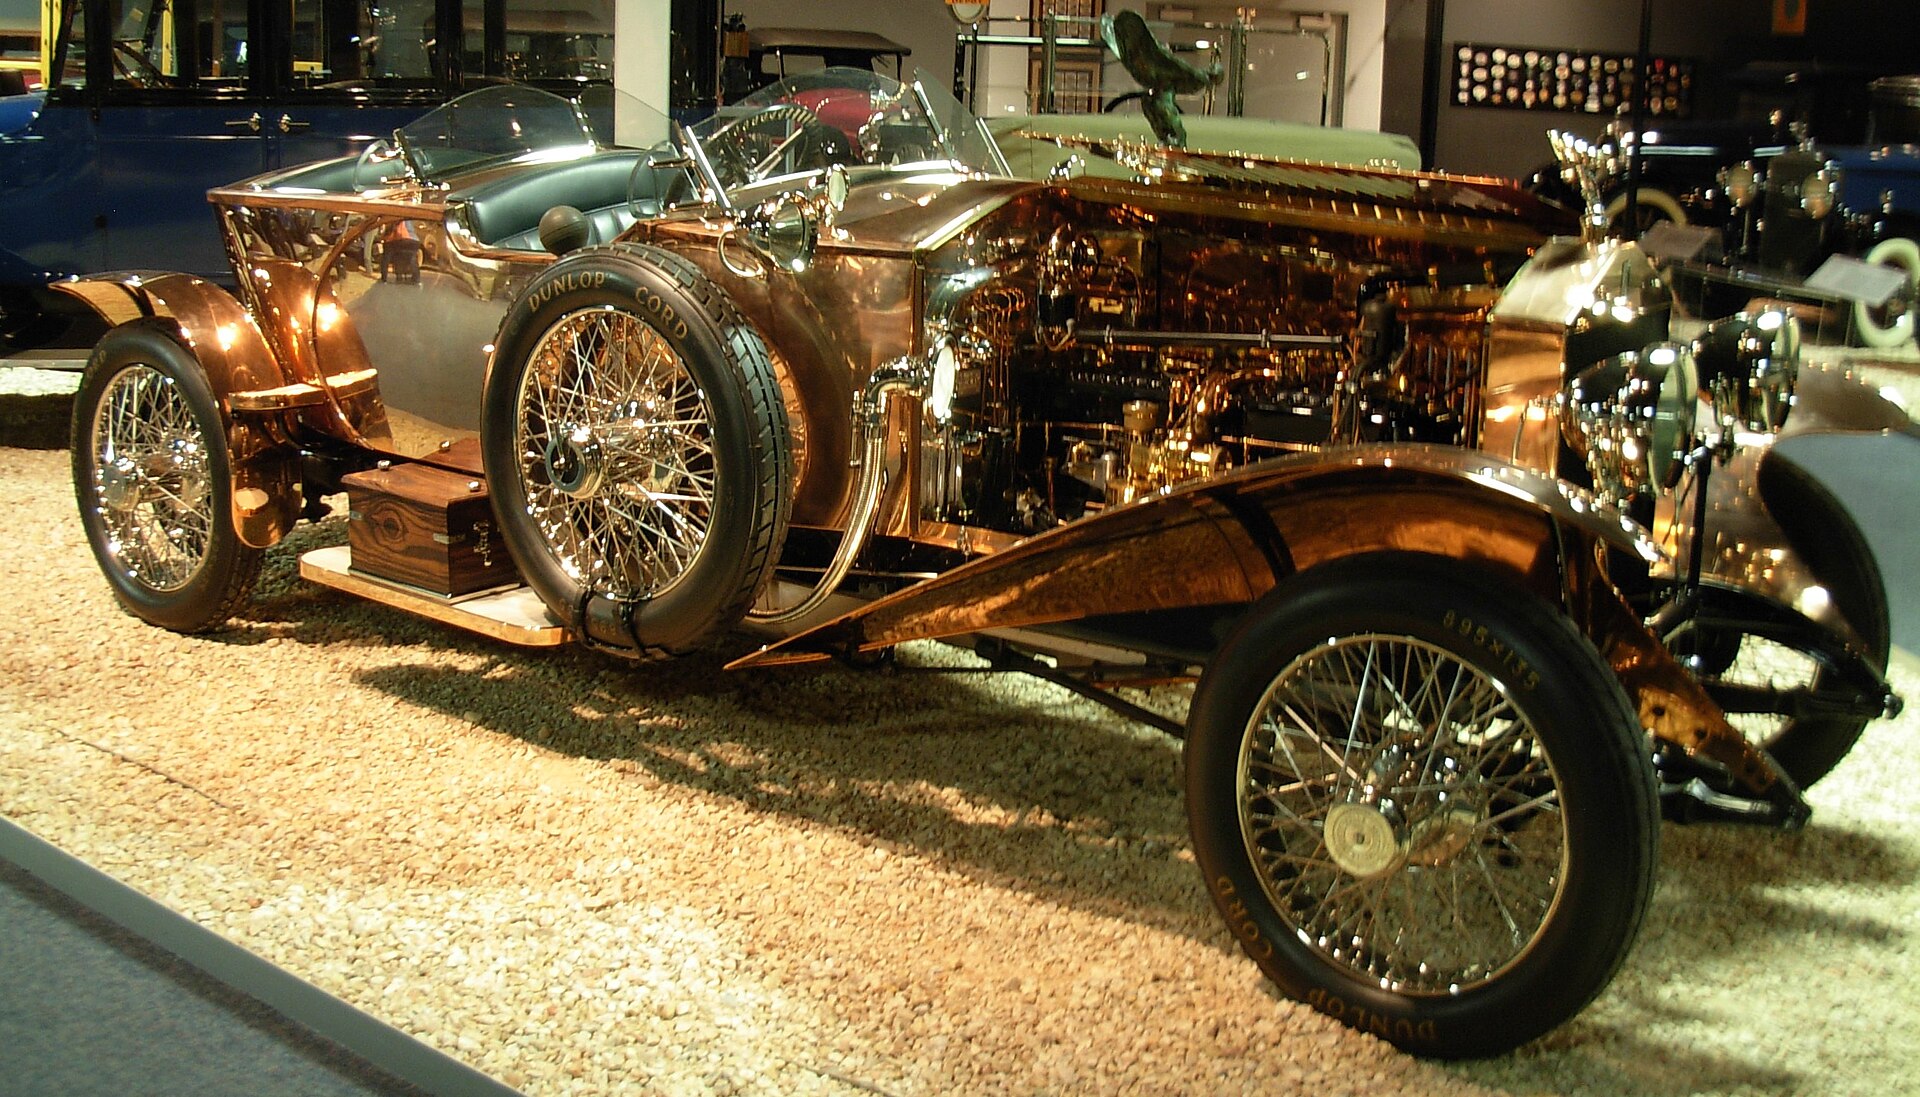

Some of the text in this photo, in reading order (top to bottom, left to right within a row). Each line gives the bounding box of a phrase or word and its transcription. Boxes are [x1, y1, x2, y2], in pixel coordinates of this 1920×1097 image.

[529, 271, 689, 340] DUNLOP CORD
[1216, 875, 1438, 1042] DUNLOP CORD
